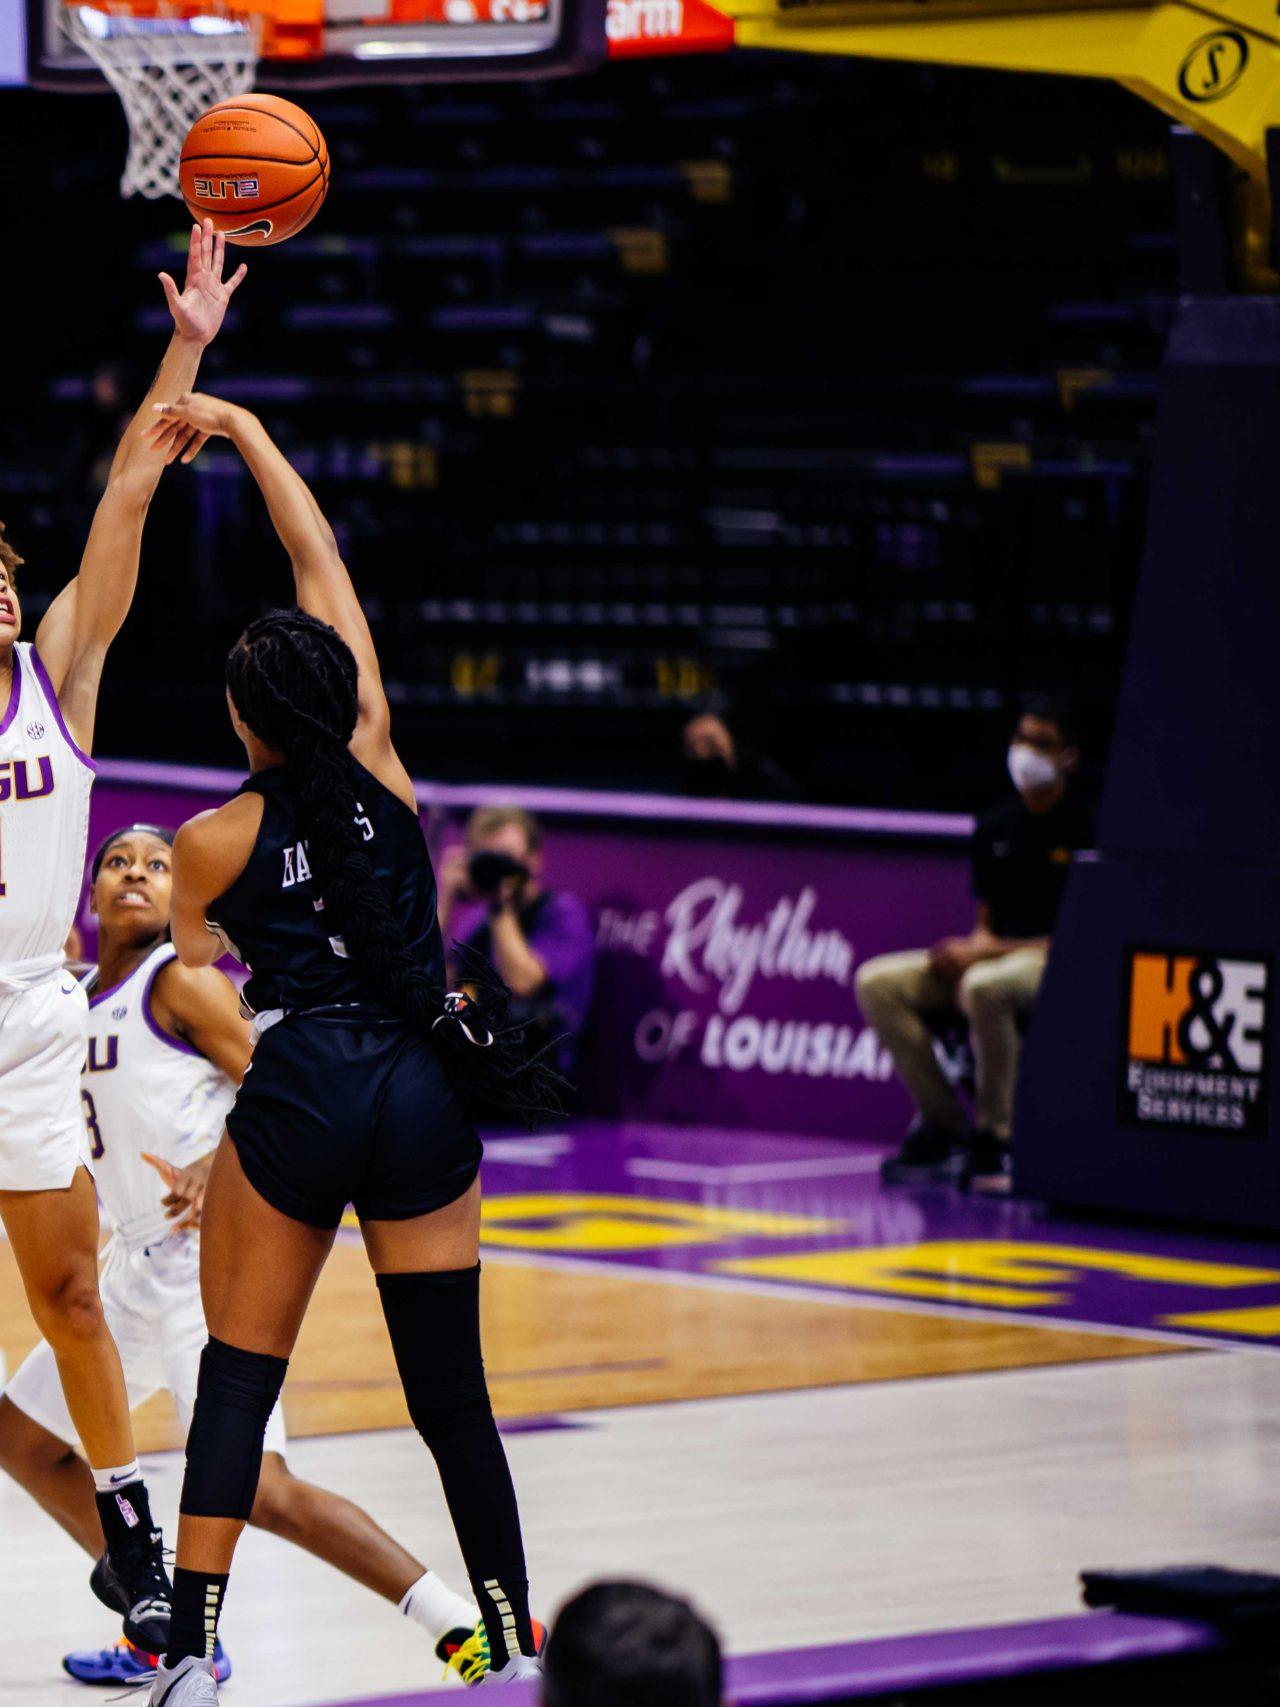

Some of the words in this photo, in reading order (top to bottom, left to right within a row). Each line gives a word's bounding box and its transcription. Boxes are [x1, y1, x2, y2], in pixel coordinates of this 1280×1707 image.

[194, 178, 260, 199] ELITE
[662, 876, 856, 1016] Rhythm
[634, 1009, 697, 1062] OF
[700, 1012, 966, 1090] LOUISIA
[1128, 952, 1266, 1073] H&E
